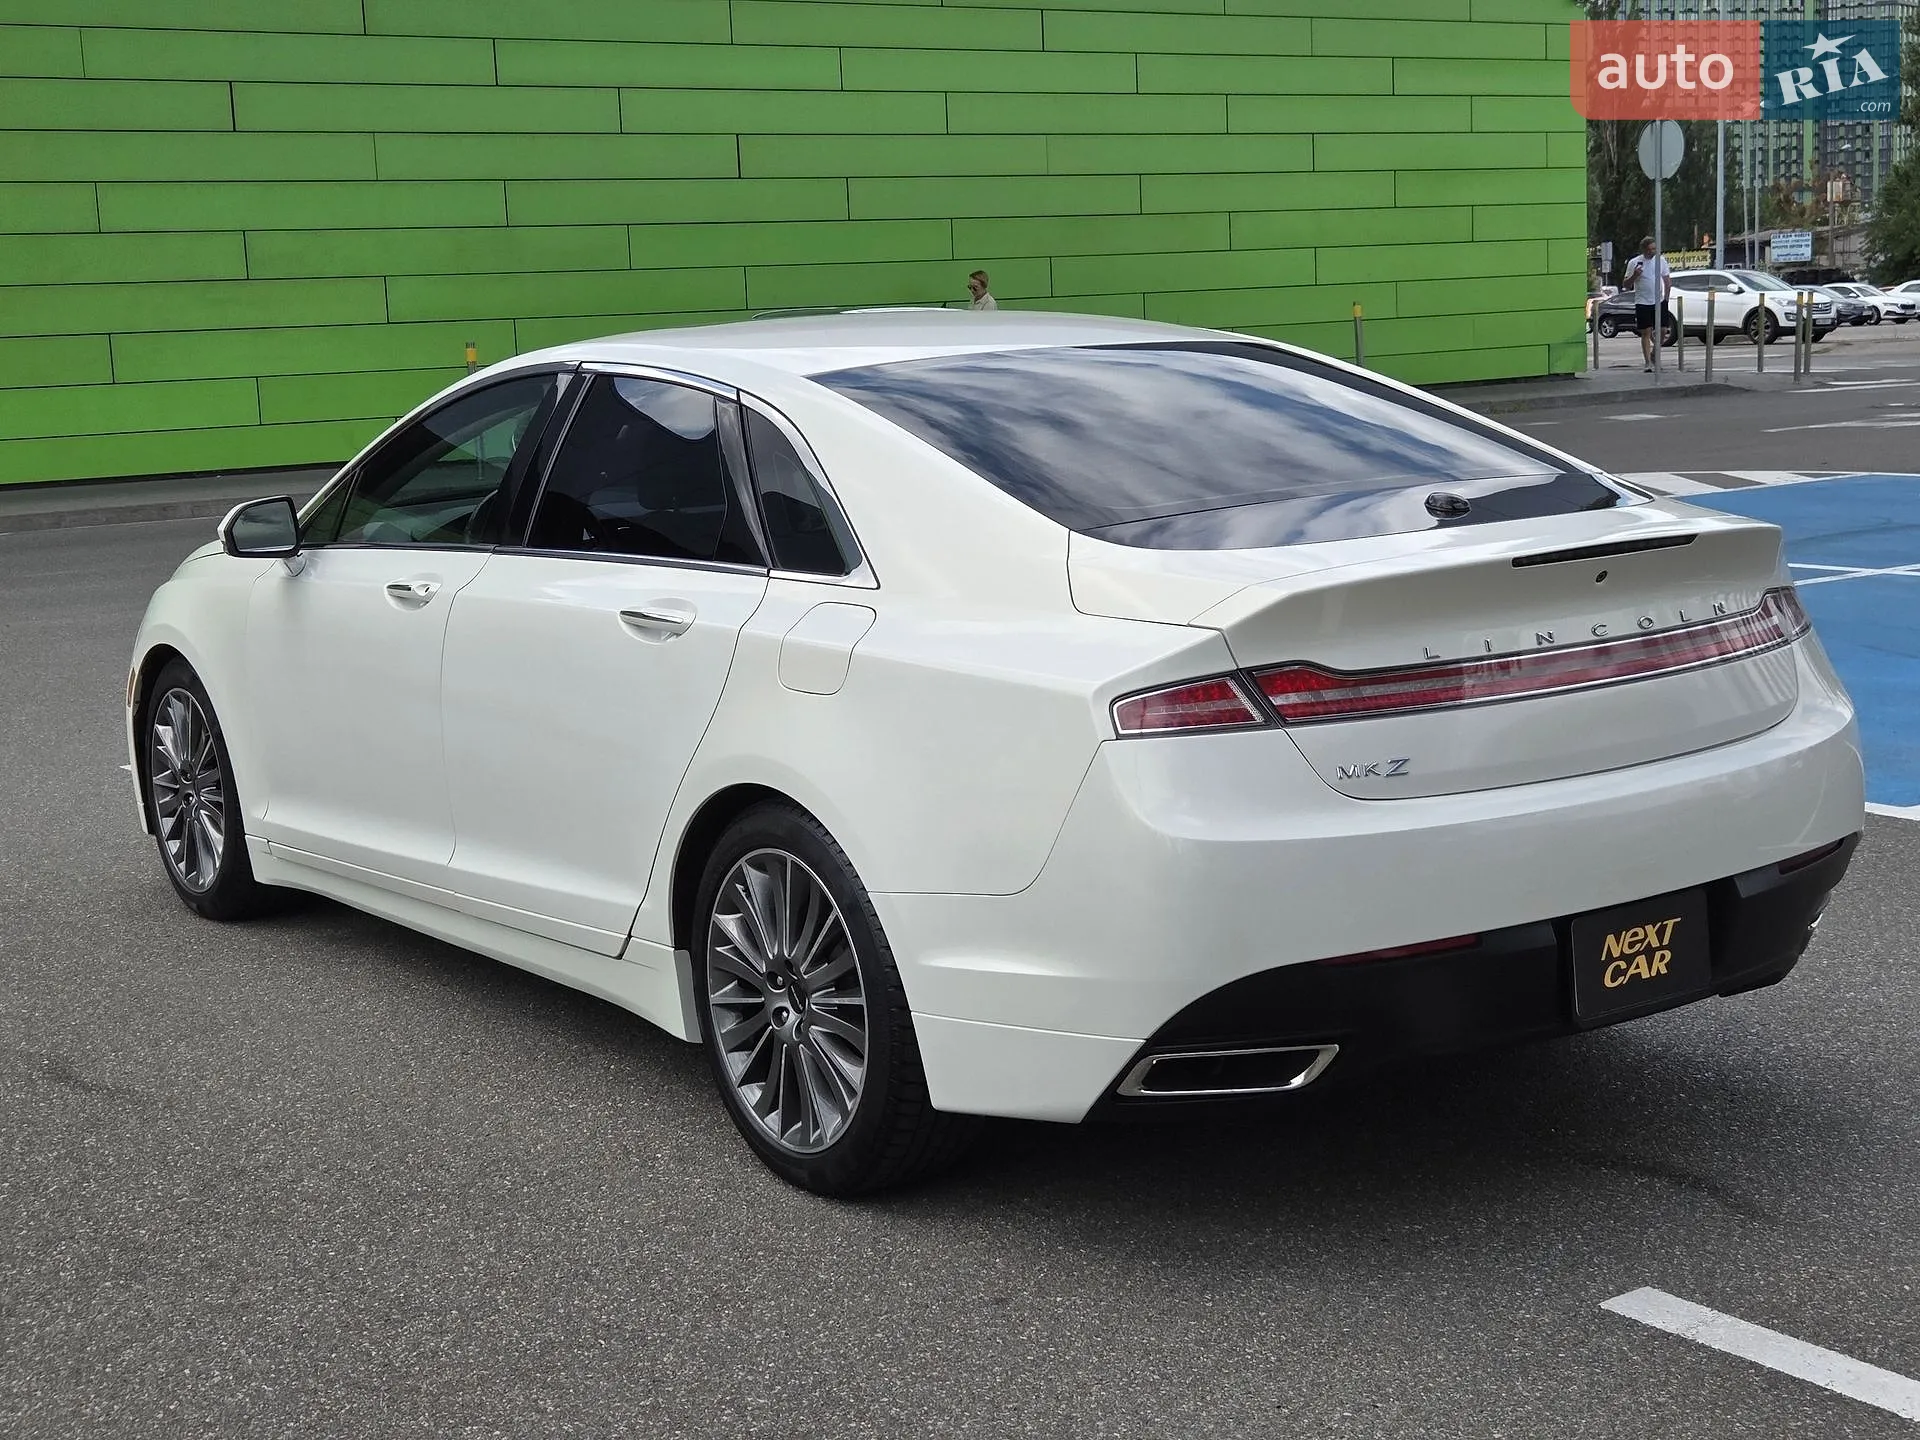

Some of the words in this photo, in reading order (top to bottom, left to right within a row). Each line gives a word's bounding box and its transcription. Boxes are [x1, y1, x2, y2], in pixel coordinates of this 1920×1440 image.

[1423, 600, 1727, 661] LINCOLN
[1336, 757, 1411, 780] MKZ
[1603, 949, 1672, 988] CAR
